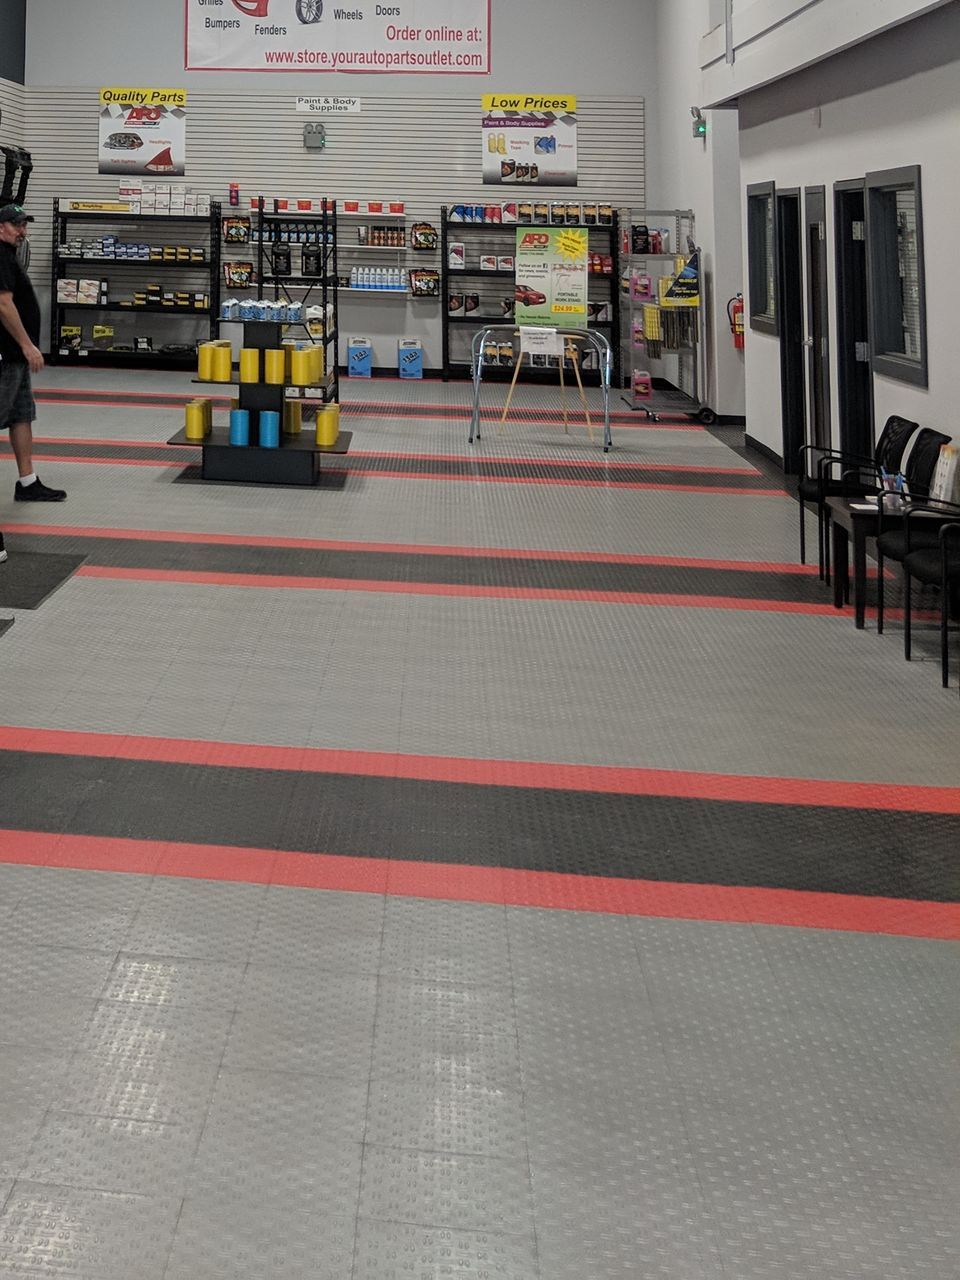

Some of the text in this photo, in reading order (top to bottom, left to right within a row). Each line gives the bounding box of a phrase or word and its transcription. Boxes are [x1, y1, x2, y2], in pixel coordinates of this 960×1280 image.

[333, 8, 363, 20] Wheels
[375, 4, 401, 16] Doors
[205, 17, 240, 30] Bumpers
[254, 24, 287, 35] Fenders
[386, 25, 482, 41] Order online at:
[265, 49, 482, 68] www.store.yourautopartsoutlet.com
[103, 90, 184, 104] Quality Parts
[491, 97, 568, 108] Low Prices
